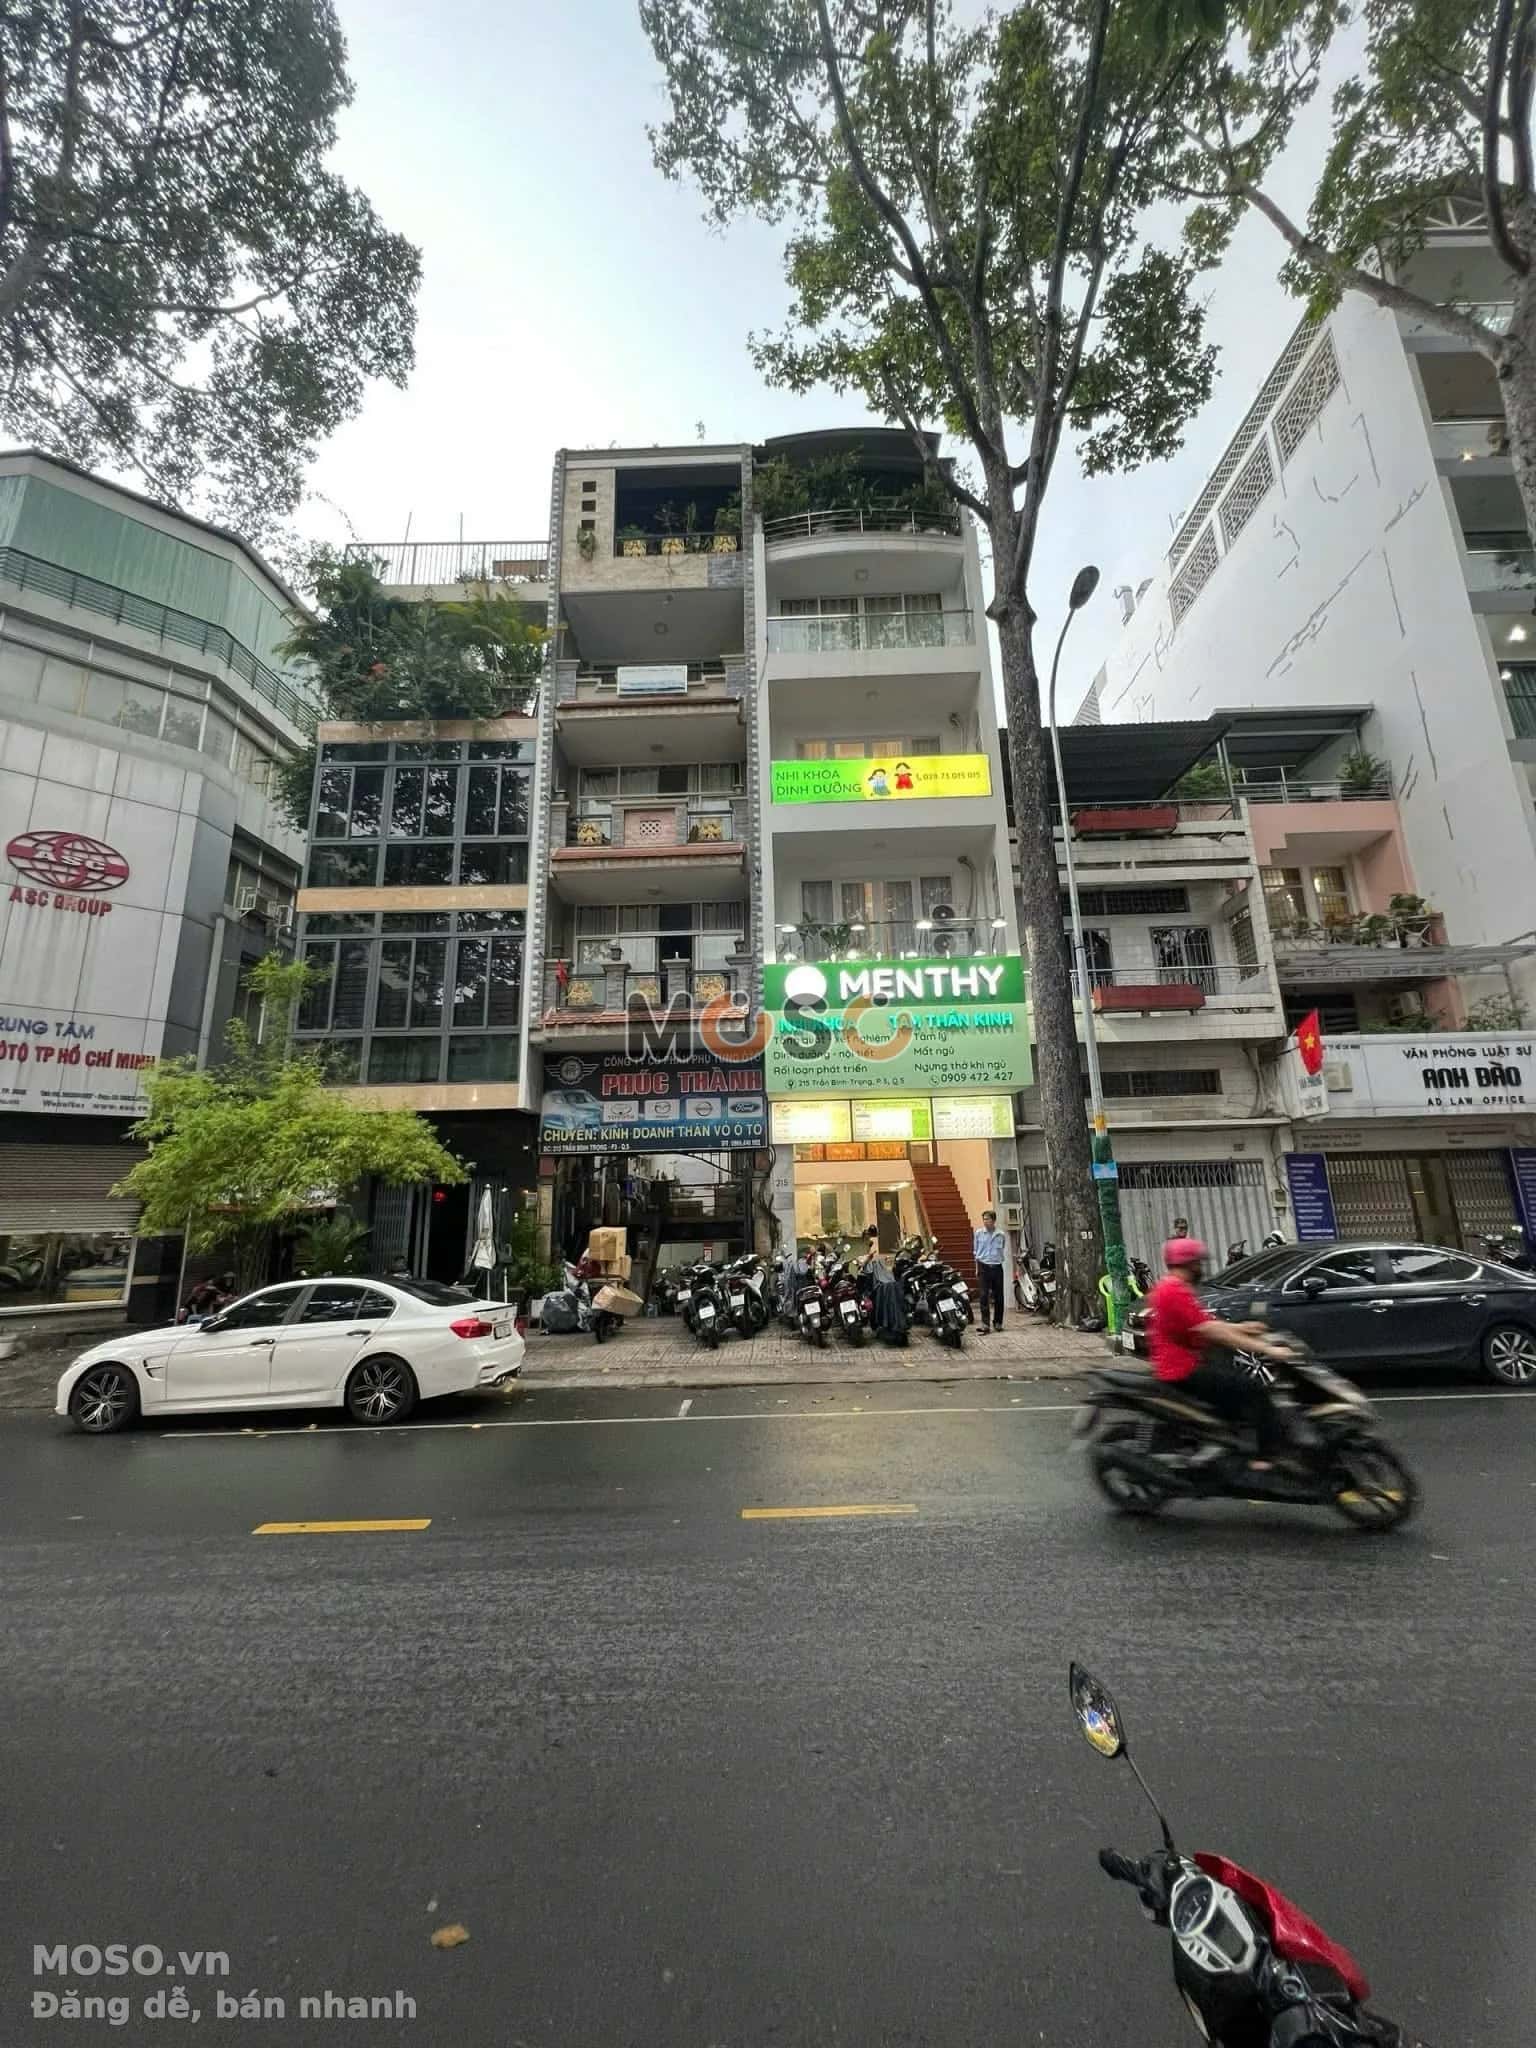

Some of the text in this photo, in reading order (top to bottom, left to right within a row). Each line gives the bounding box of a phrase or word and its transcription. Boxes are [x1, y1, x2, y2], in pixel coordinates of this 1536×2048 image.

[776, 770, 799, 781] NHI
[776, 785, 809, 796] DINH
[9, 886, 112, 917] ASC GROUP
[839, 964, 1004, 1000] MENTHY
[975, 1011, 1014, 1027] KINH
[55, 1020, 95, 1040] TÂM
[35, 1045, 55, 1063] TP
[85, 1048, 114, 1068] CHÍ
[1402, 1047, 1428, 1059] VĂN
[970, 1060, 985, 1070] khi
[602, 1066, 763, 1096] PHÚC THÀNH
[941, 1071, 1014, 1083] 0909 472 427
[1422, 1067, 1469, 1089] ANH
[1428, 1095, 1526, 1106] AD LAW OFFICE
[601, 1127, 629, 1140] KINH
[633, 1126, 674, 1139] DOANH
